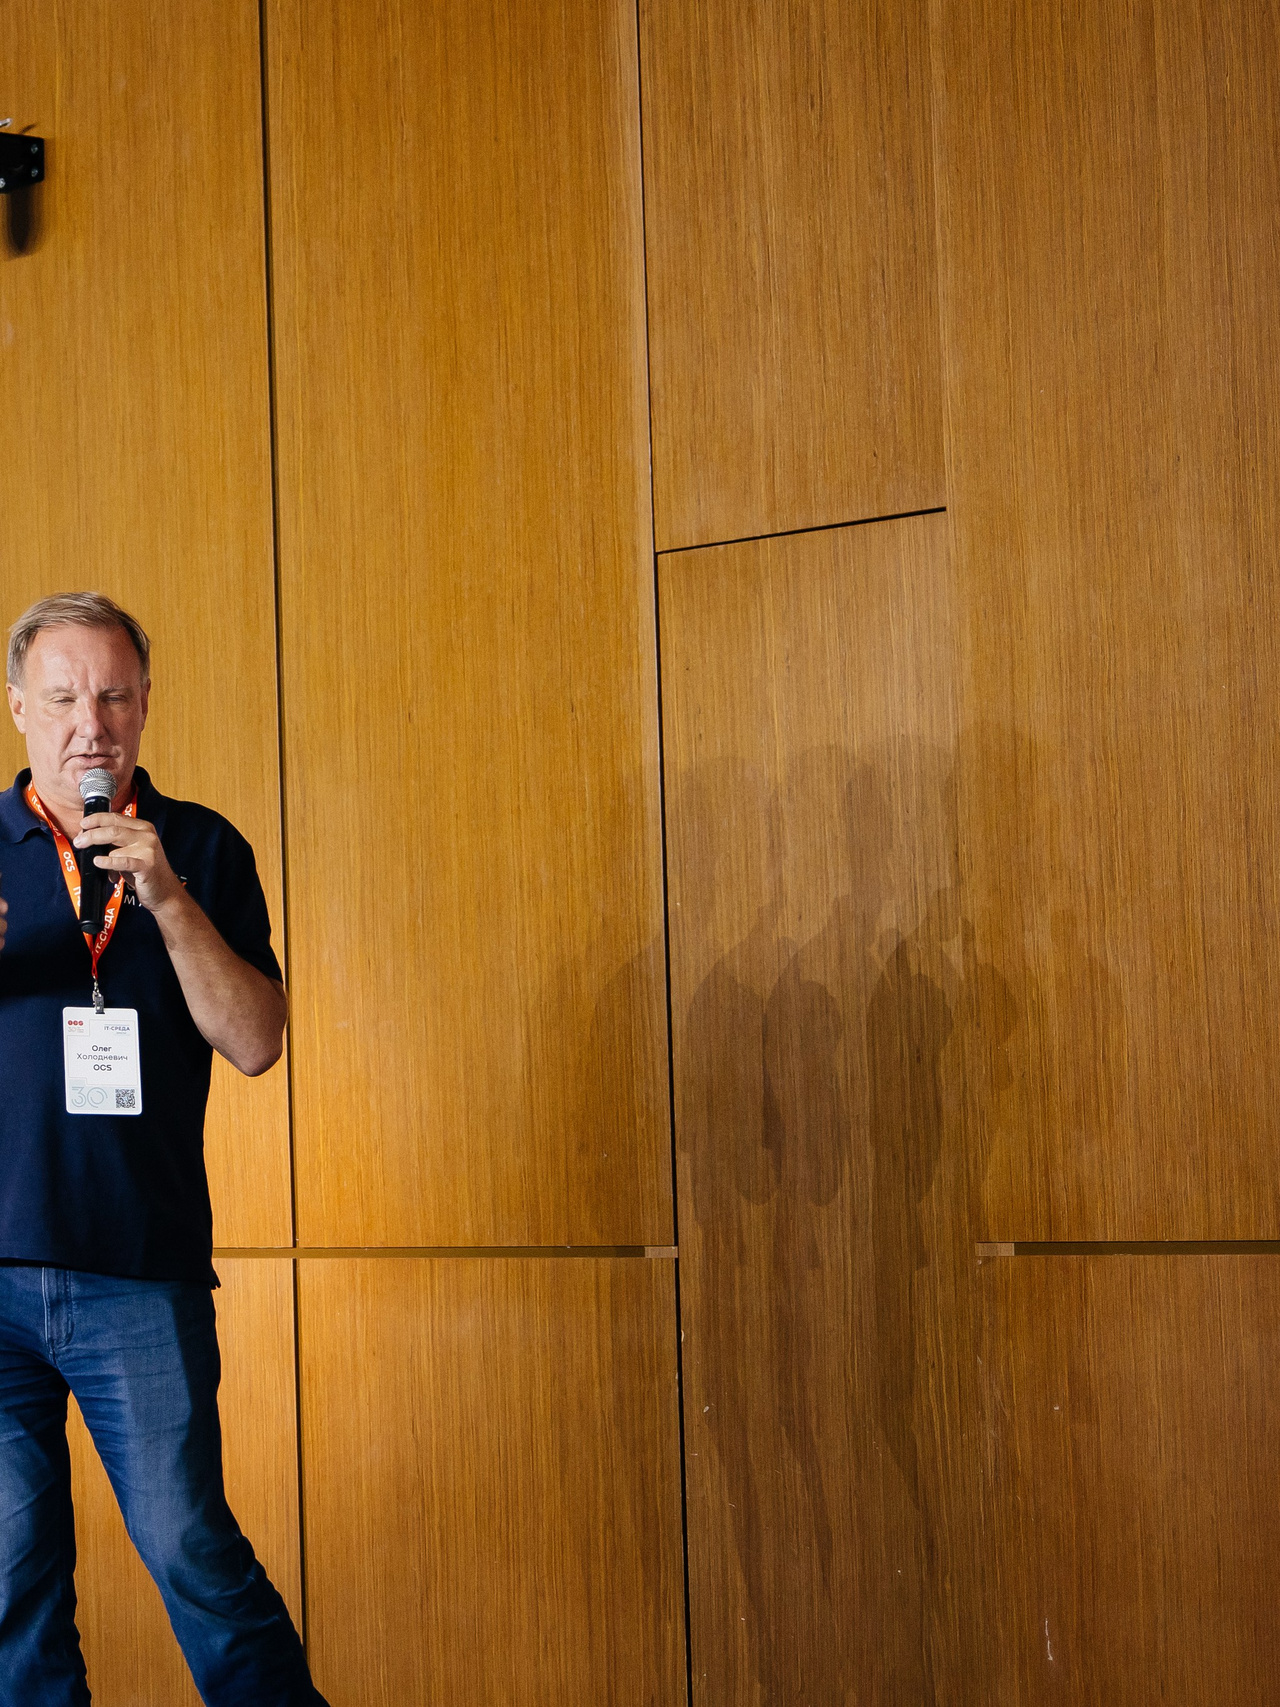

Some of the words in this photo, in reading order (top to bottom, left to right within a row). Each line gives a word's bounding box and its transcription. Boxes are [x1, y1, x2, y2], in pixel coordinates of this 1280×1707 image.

[63, 851, 76, 873] OCS
[95, 907, 116, 954] IT-СРЕДА
[76, 1053, 128, 1061] Холодкевич
[71, 1086, 108, 1109] 30
